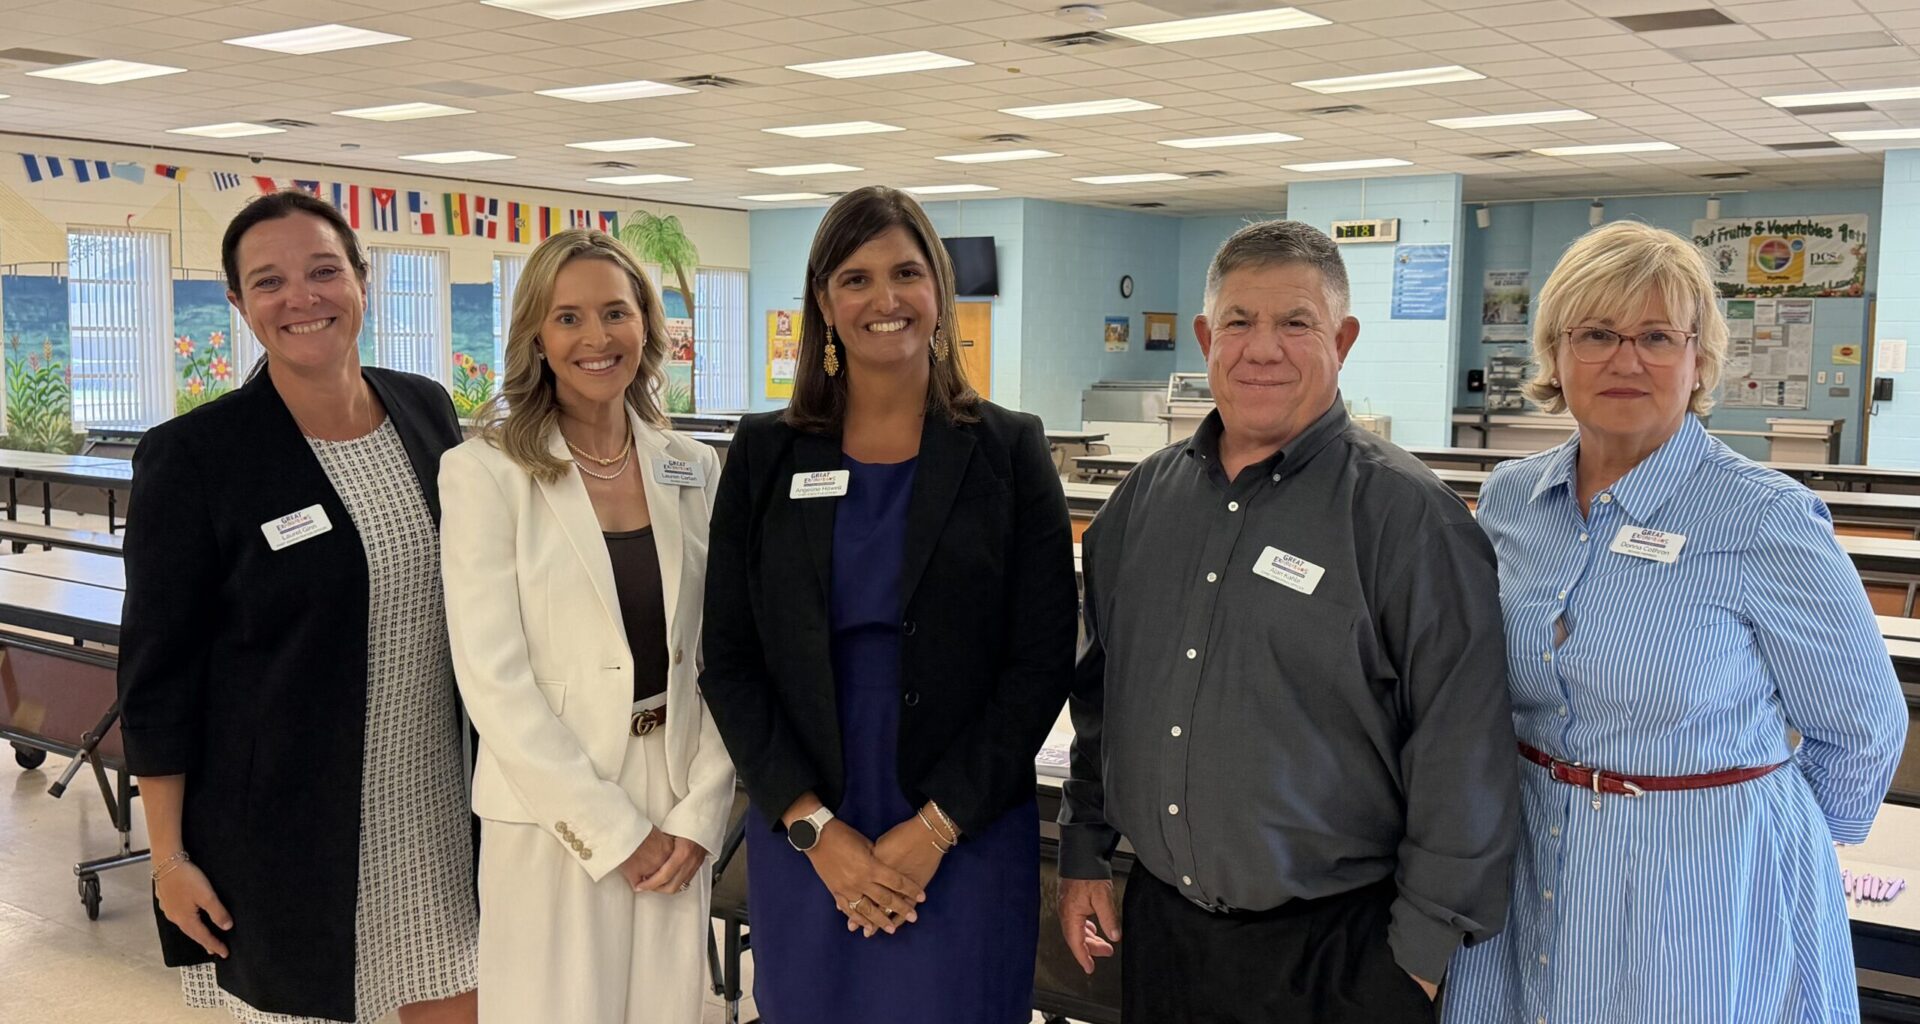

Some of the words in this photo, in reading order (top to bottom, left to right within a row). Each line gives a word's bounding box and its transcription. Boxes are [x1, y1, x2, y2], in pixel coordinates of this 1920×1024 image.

[1717, 222, 1752, 243] Fruits
[1754, 220, 1766, 236] &
[1767, 219, 1833, 240] Vegetables
[280, 512, 302, 524] GREAT
[1641, 529, 1665, 538] GREAT
[1620, 541, 1642, 551] Donna
[1282, 554, 1305, 567] GREAT
